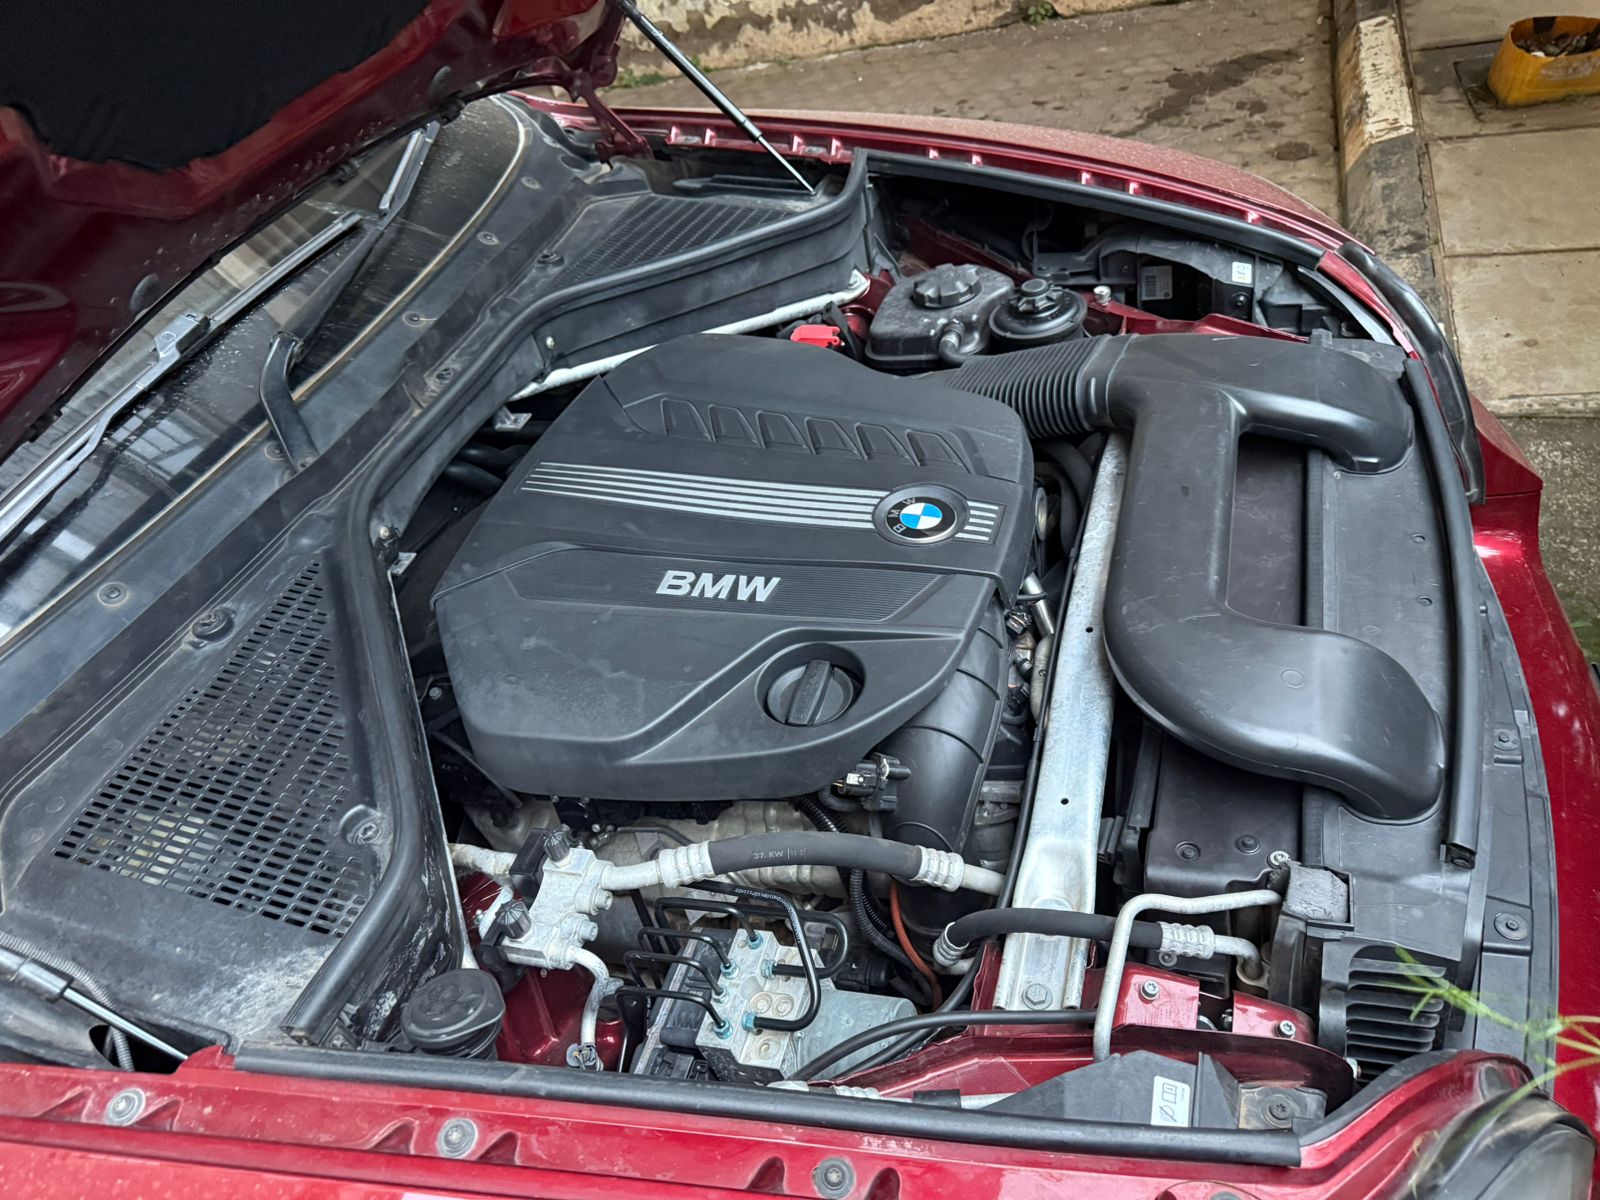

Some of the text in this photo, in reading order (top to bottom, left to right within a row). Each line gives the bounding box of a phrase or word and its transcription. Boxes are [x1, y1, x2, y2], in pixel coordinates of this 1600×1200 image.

[887, 497, 917, 534] BMW
[655, 569, 781, 602] BMW
[768, 850, 784, 858] KW
